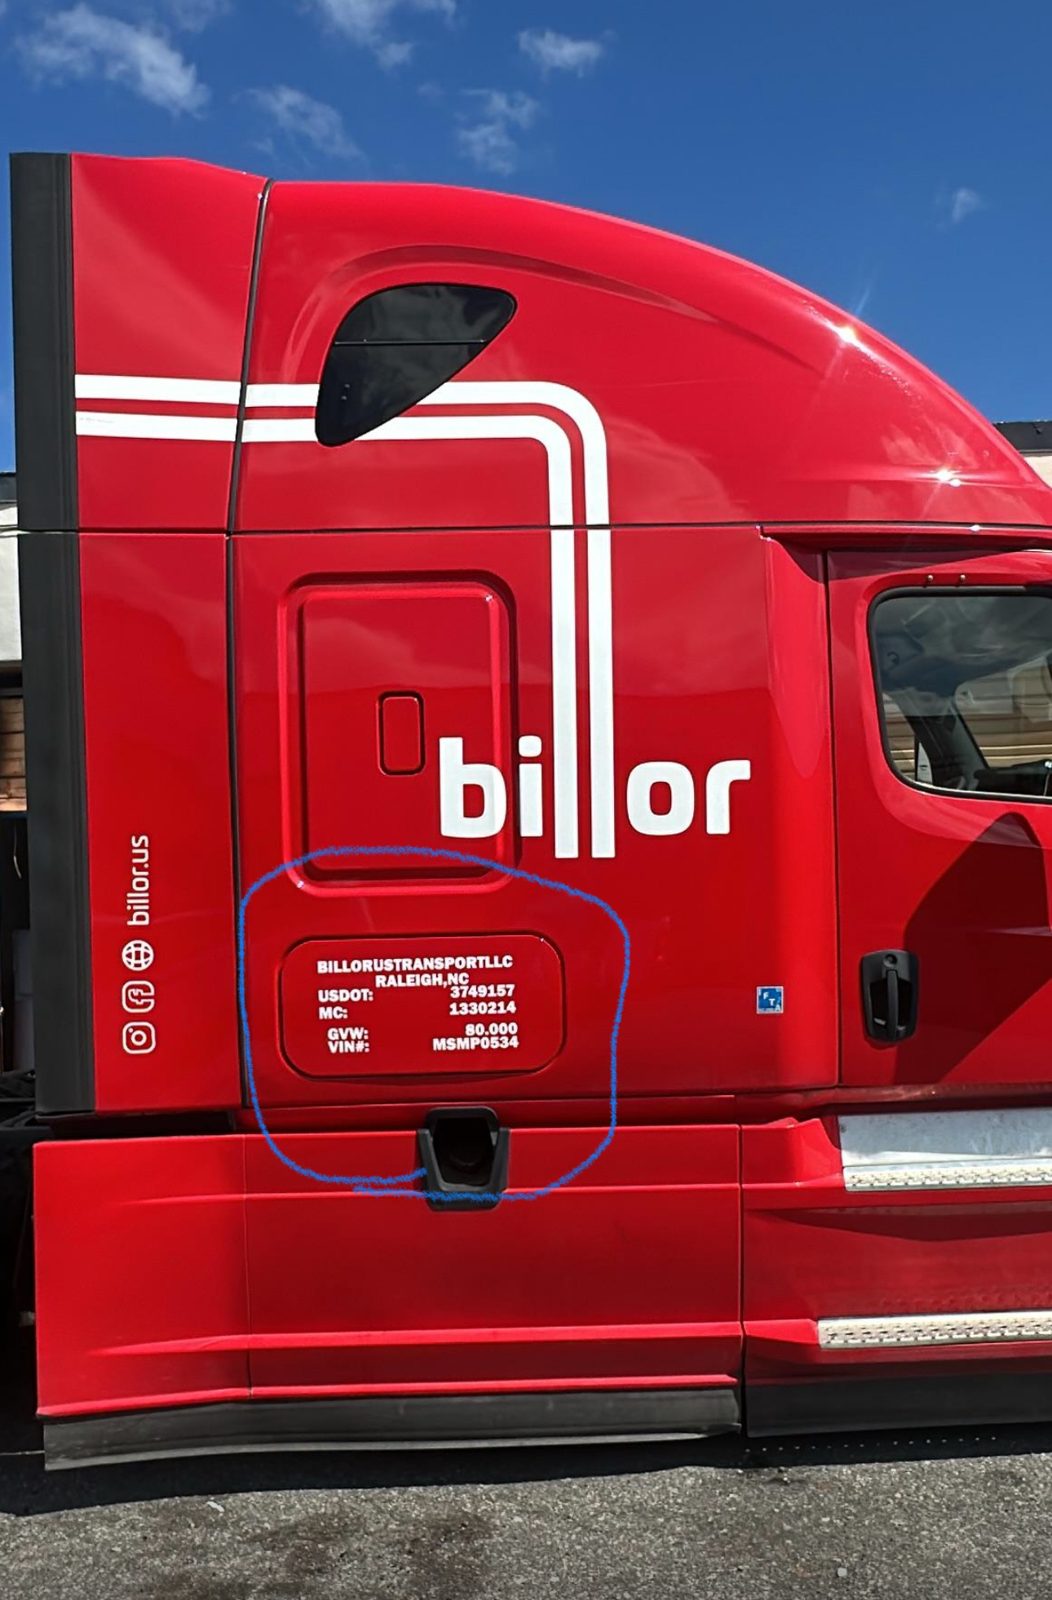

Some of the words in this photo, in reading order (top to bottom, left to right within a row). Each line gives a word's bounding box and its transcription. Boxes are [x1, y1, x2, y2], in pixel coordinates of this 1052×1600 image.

[439, 735, 751, 858] billor
[126, 834, 150, 926] billor.us
[375, 972, 470, 989] RALEIGH,NC
[317, 988, 374, 1003] USDOT:
[450, 983, 516, 999] 3749157
[318, 1006, 349, 1020] MC:
[449, 1001, 517, 1016] 1330214
[327, 1027, 369, 1041] GVW:
[328, 1040, 370, 1054] VIN#:
[432, 1035, 519, 1051] MSMP0534
